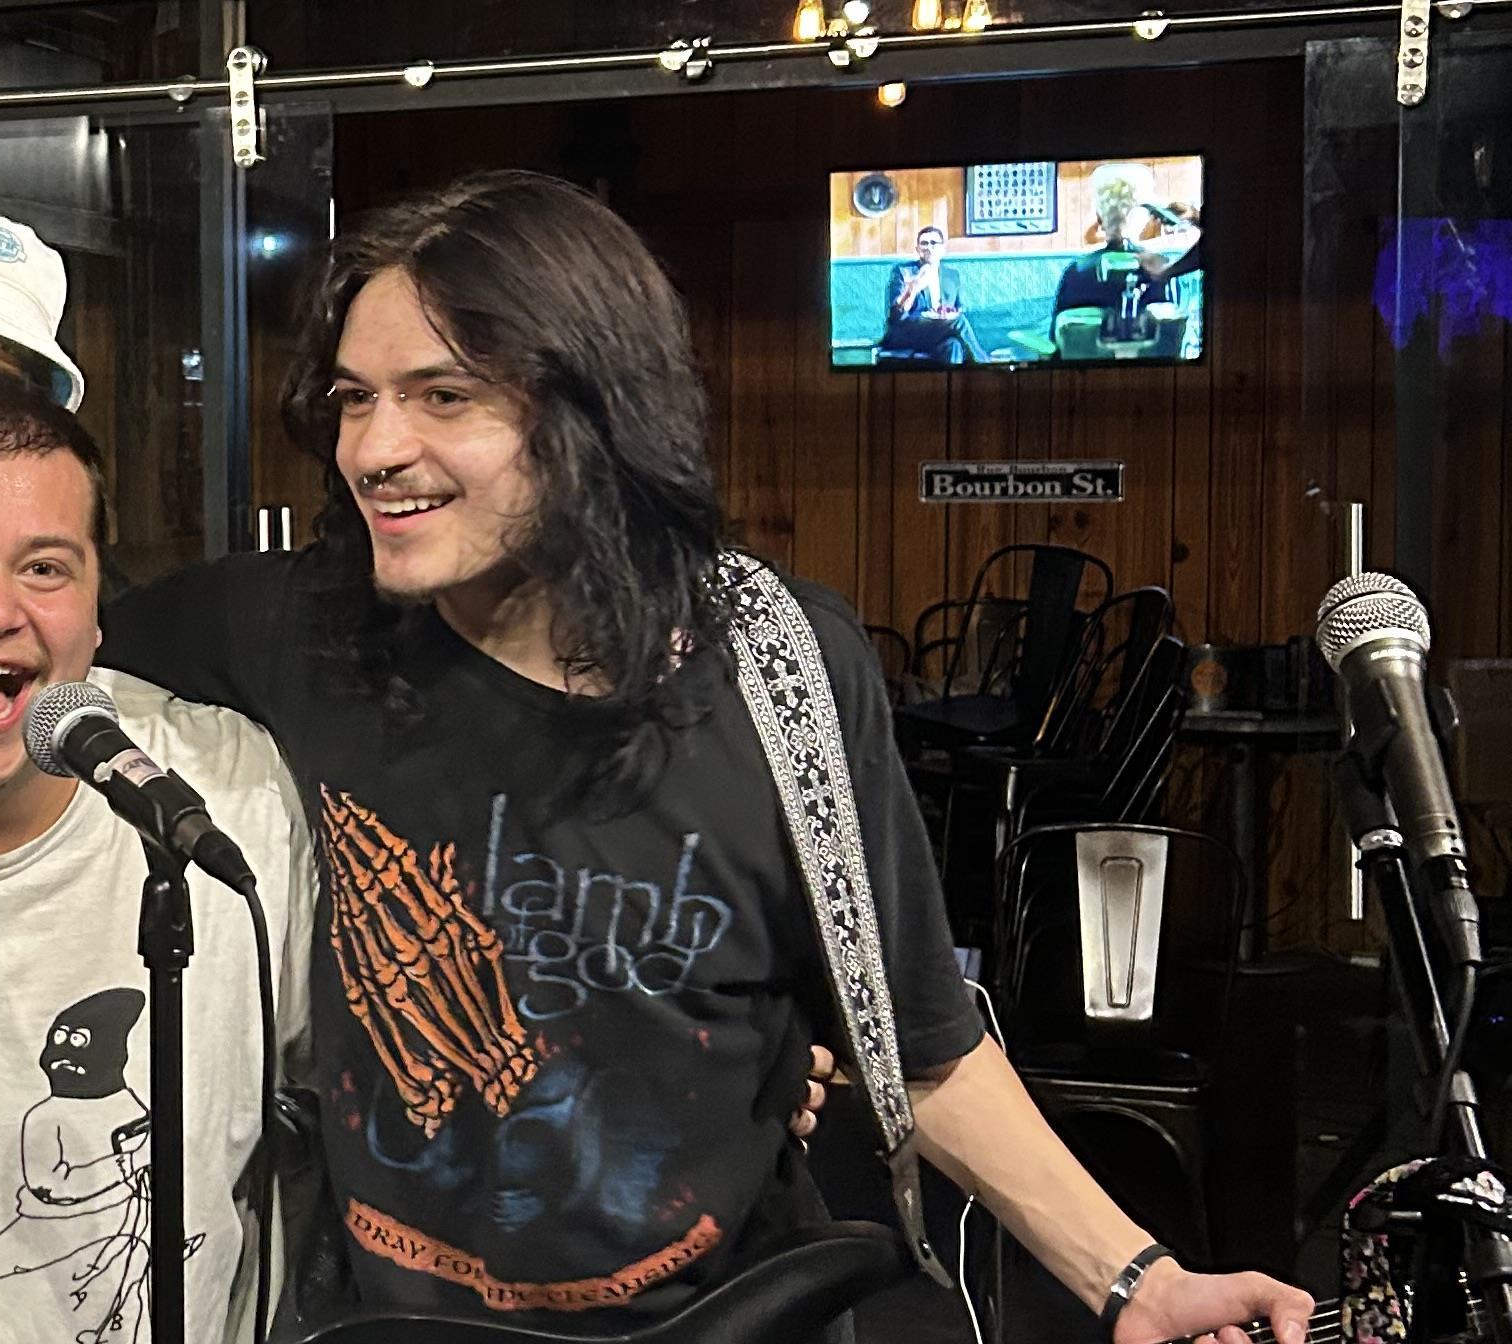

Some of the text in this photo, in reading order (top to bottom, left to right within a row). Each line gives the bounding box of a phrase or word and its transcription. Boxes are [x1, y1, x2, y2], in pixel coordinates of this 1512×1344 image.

[932, 473, 1114, 496] Bourbon St.
[482, 792, 732, 974] lamb
